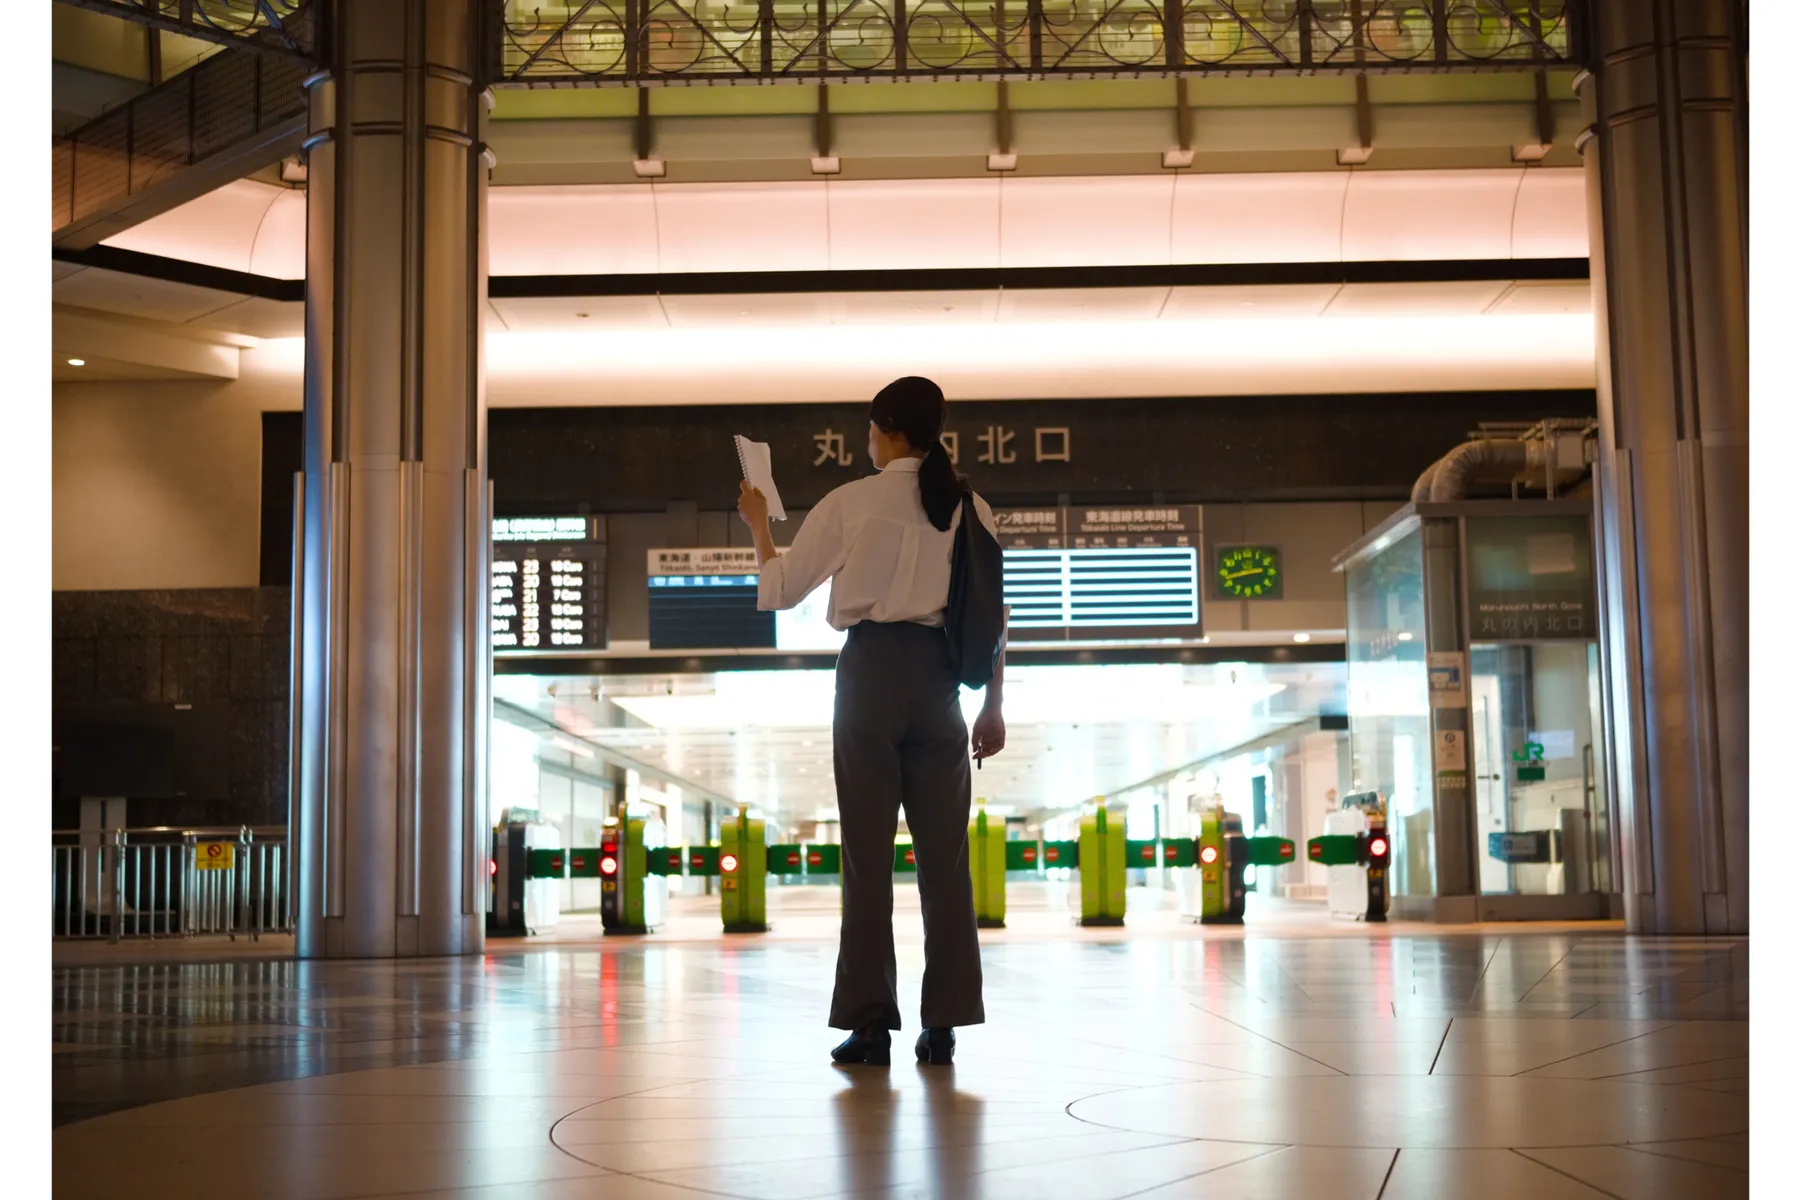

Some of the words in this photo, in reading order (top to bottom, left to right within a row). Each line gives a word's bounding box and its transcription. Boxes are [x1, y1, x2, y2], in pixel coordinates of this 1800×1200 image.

[813, 426, 1071, 466] 丸北口
[1481, 615, 1582, 633] 丸の内北口
[1512, 742, 1545, 761] JR
